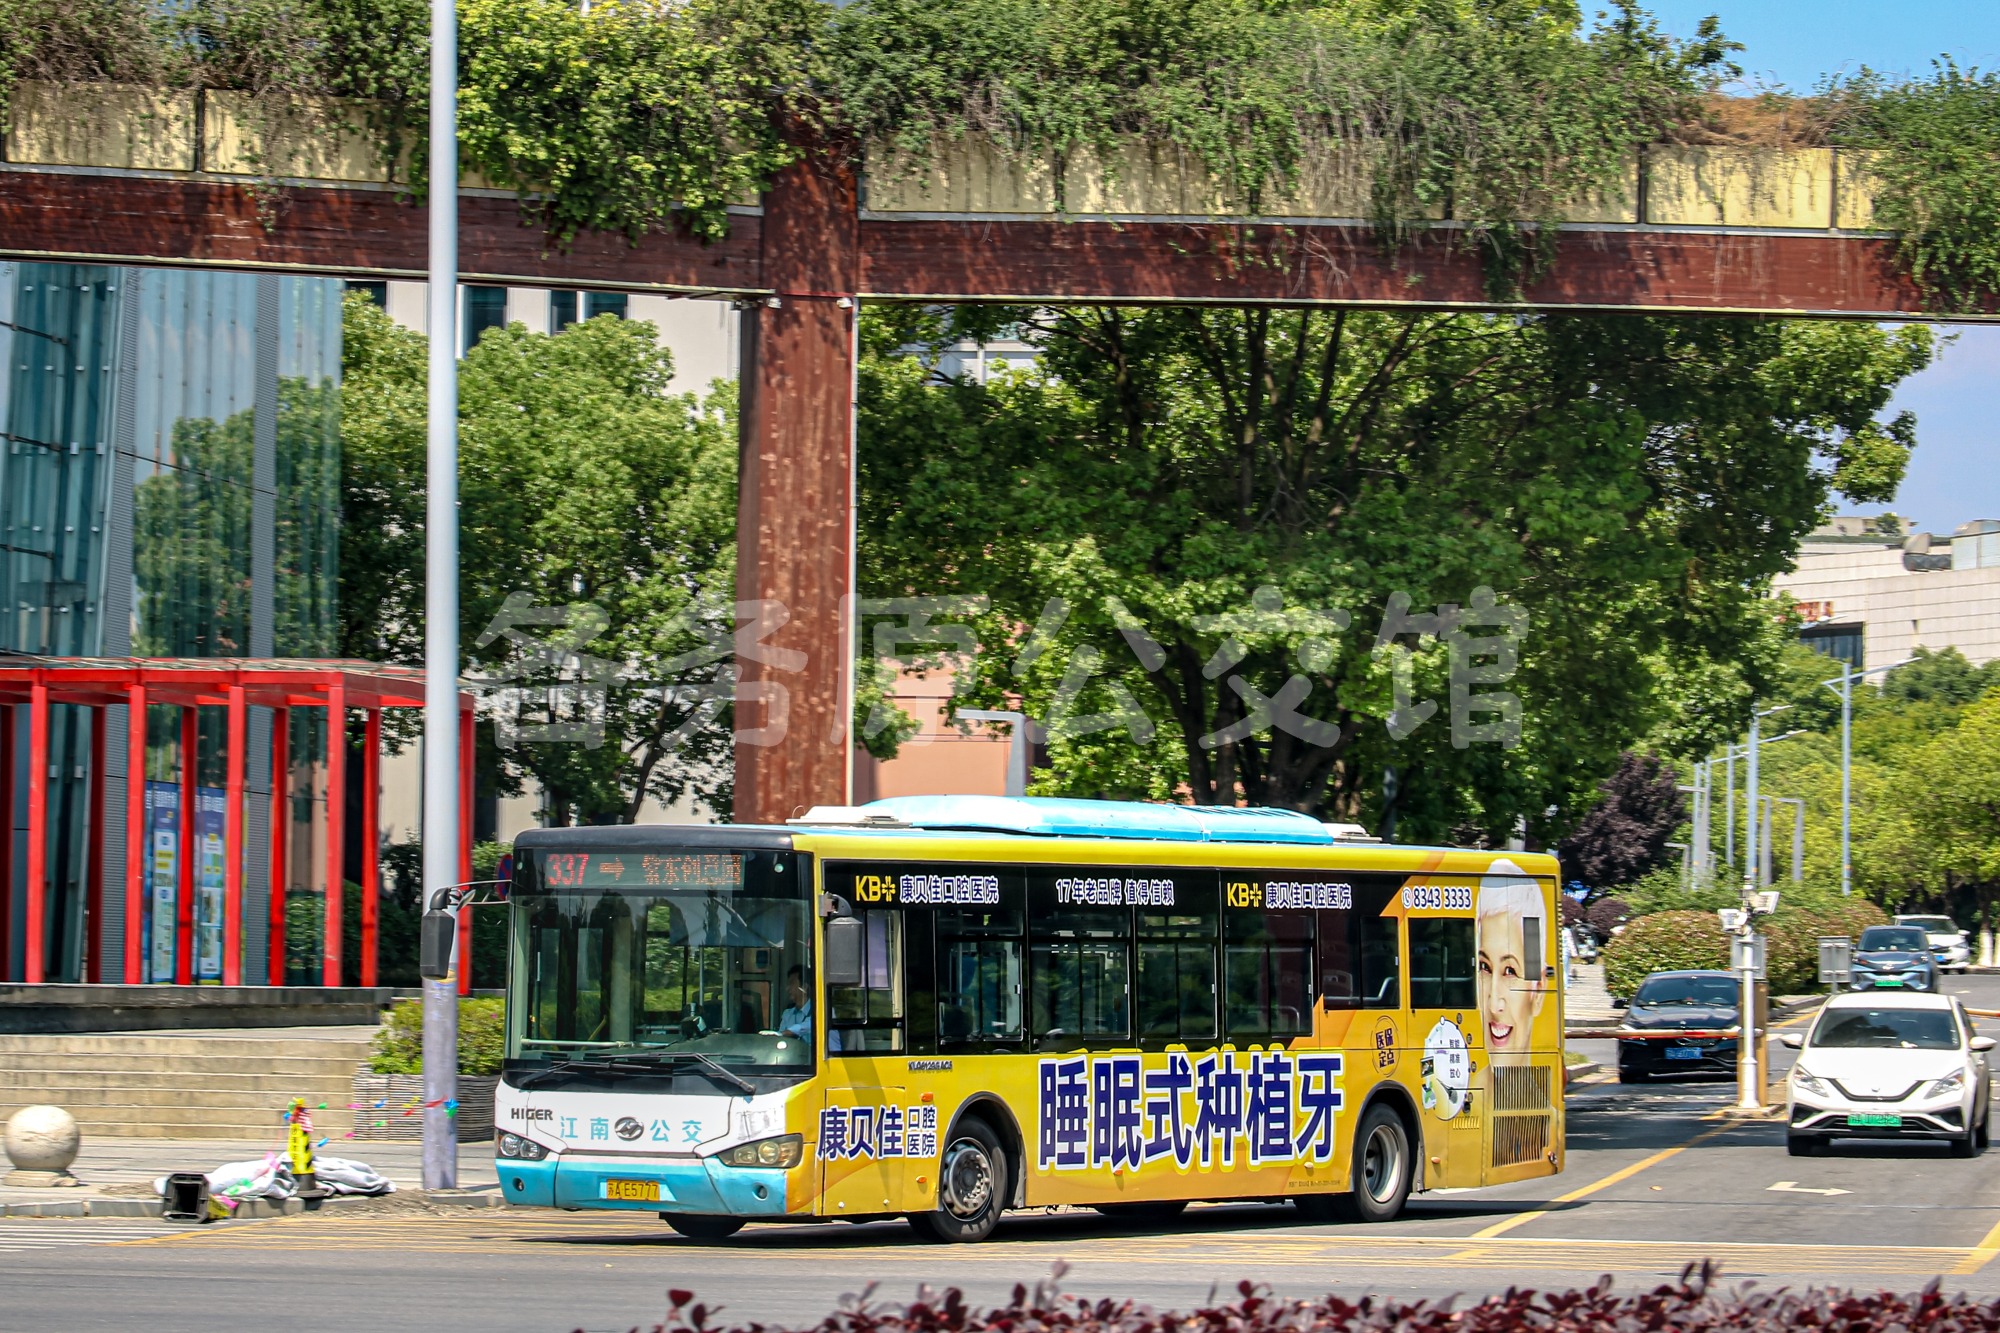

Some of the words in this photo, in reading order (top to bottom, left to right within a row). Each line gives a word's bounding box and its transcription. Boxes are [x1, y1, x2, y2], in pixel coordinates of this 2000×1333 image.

[548, 854, 590, 886] 337
[855, 876, 881, 901] KB
[900, 875, 999, 903] 康贝佳口腔医院
[1056, 878, 1122, 905] 17年老品牌
[1125, 878, 1174, 906] 值得信赖
[1227, 882, 1248, 907] KB
[1265, 881, 1352, 909] 康贝佳口腔医院
[1376, 1028, 1394, 1050] 医保
[1377, 1050, 1395, 1068] 定点
[511, 1108, 553, 1120] HIGER
[907, 1105, 937, 1131] 口腔
[1038, 1052, 1343, 1170] 睡眠式种植牙
[817, 1105, 904, 1161] 康贝佳
[906, 1131, 936, 1158] 医院
